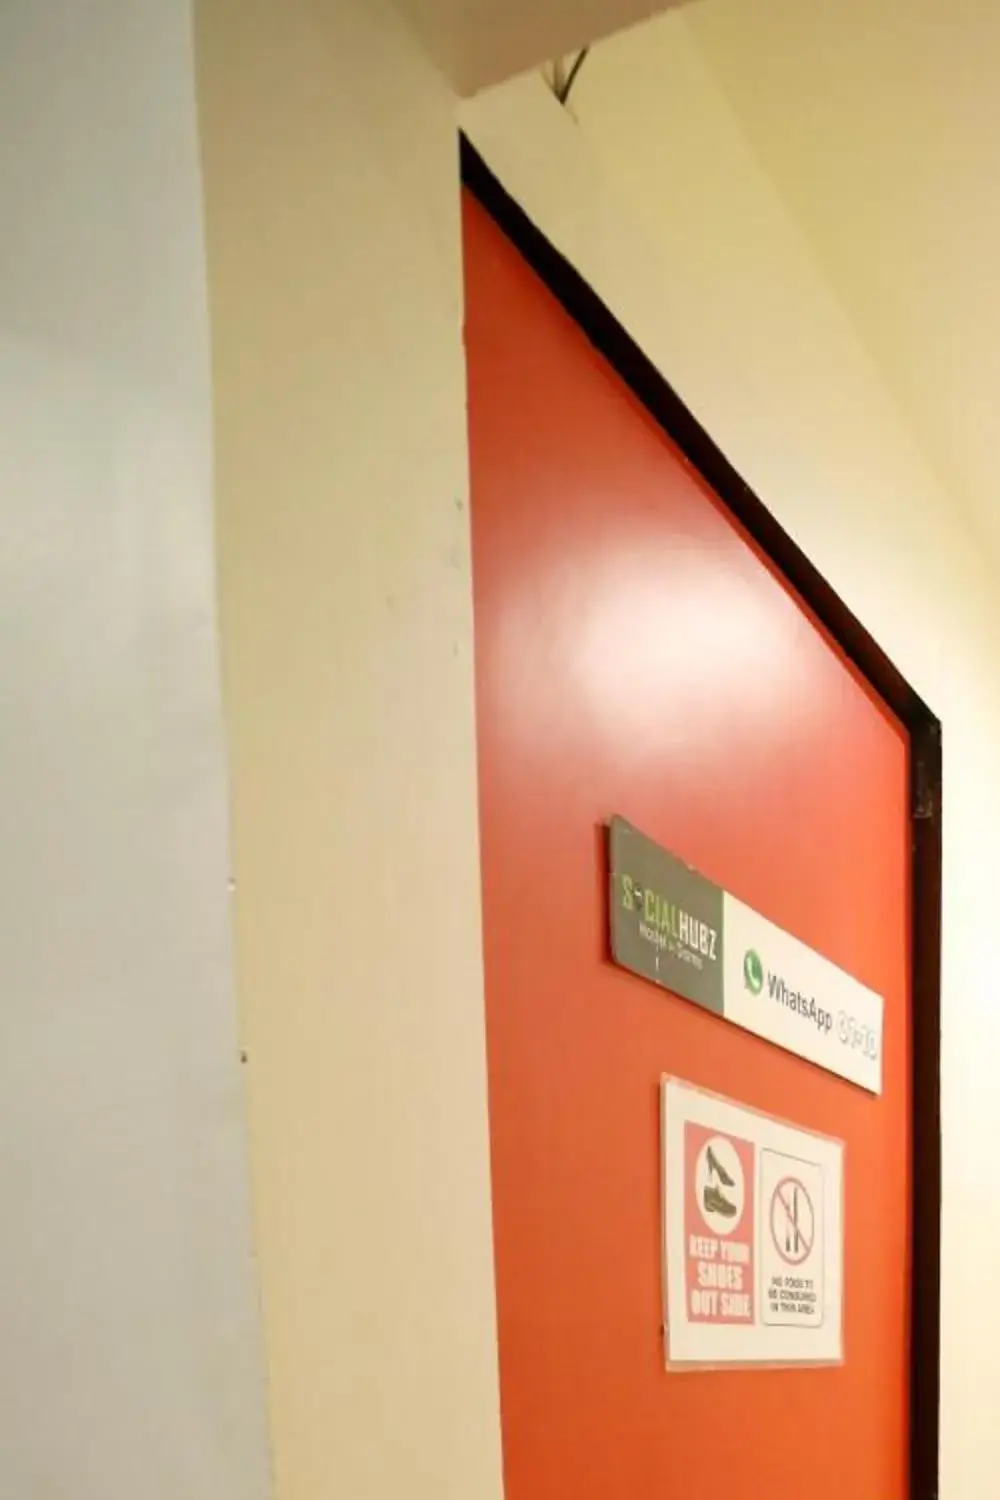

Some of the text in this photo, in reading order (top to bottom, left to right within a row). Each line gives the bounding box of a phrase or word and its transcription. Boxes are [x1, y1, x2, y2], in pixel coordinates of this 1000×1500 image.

[767, 969, 832, 1033] WhatsApp
[690, 1234, 718, 1259] KEEP
[698, 1261, 743, 1291] SHOES
[691, 1289, 718, 1316] OUT
